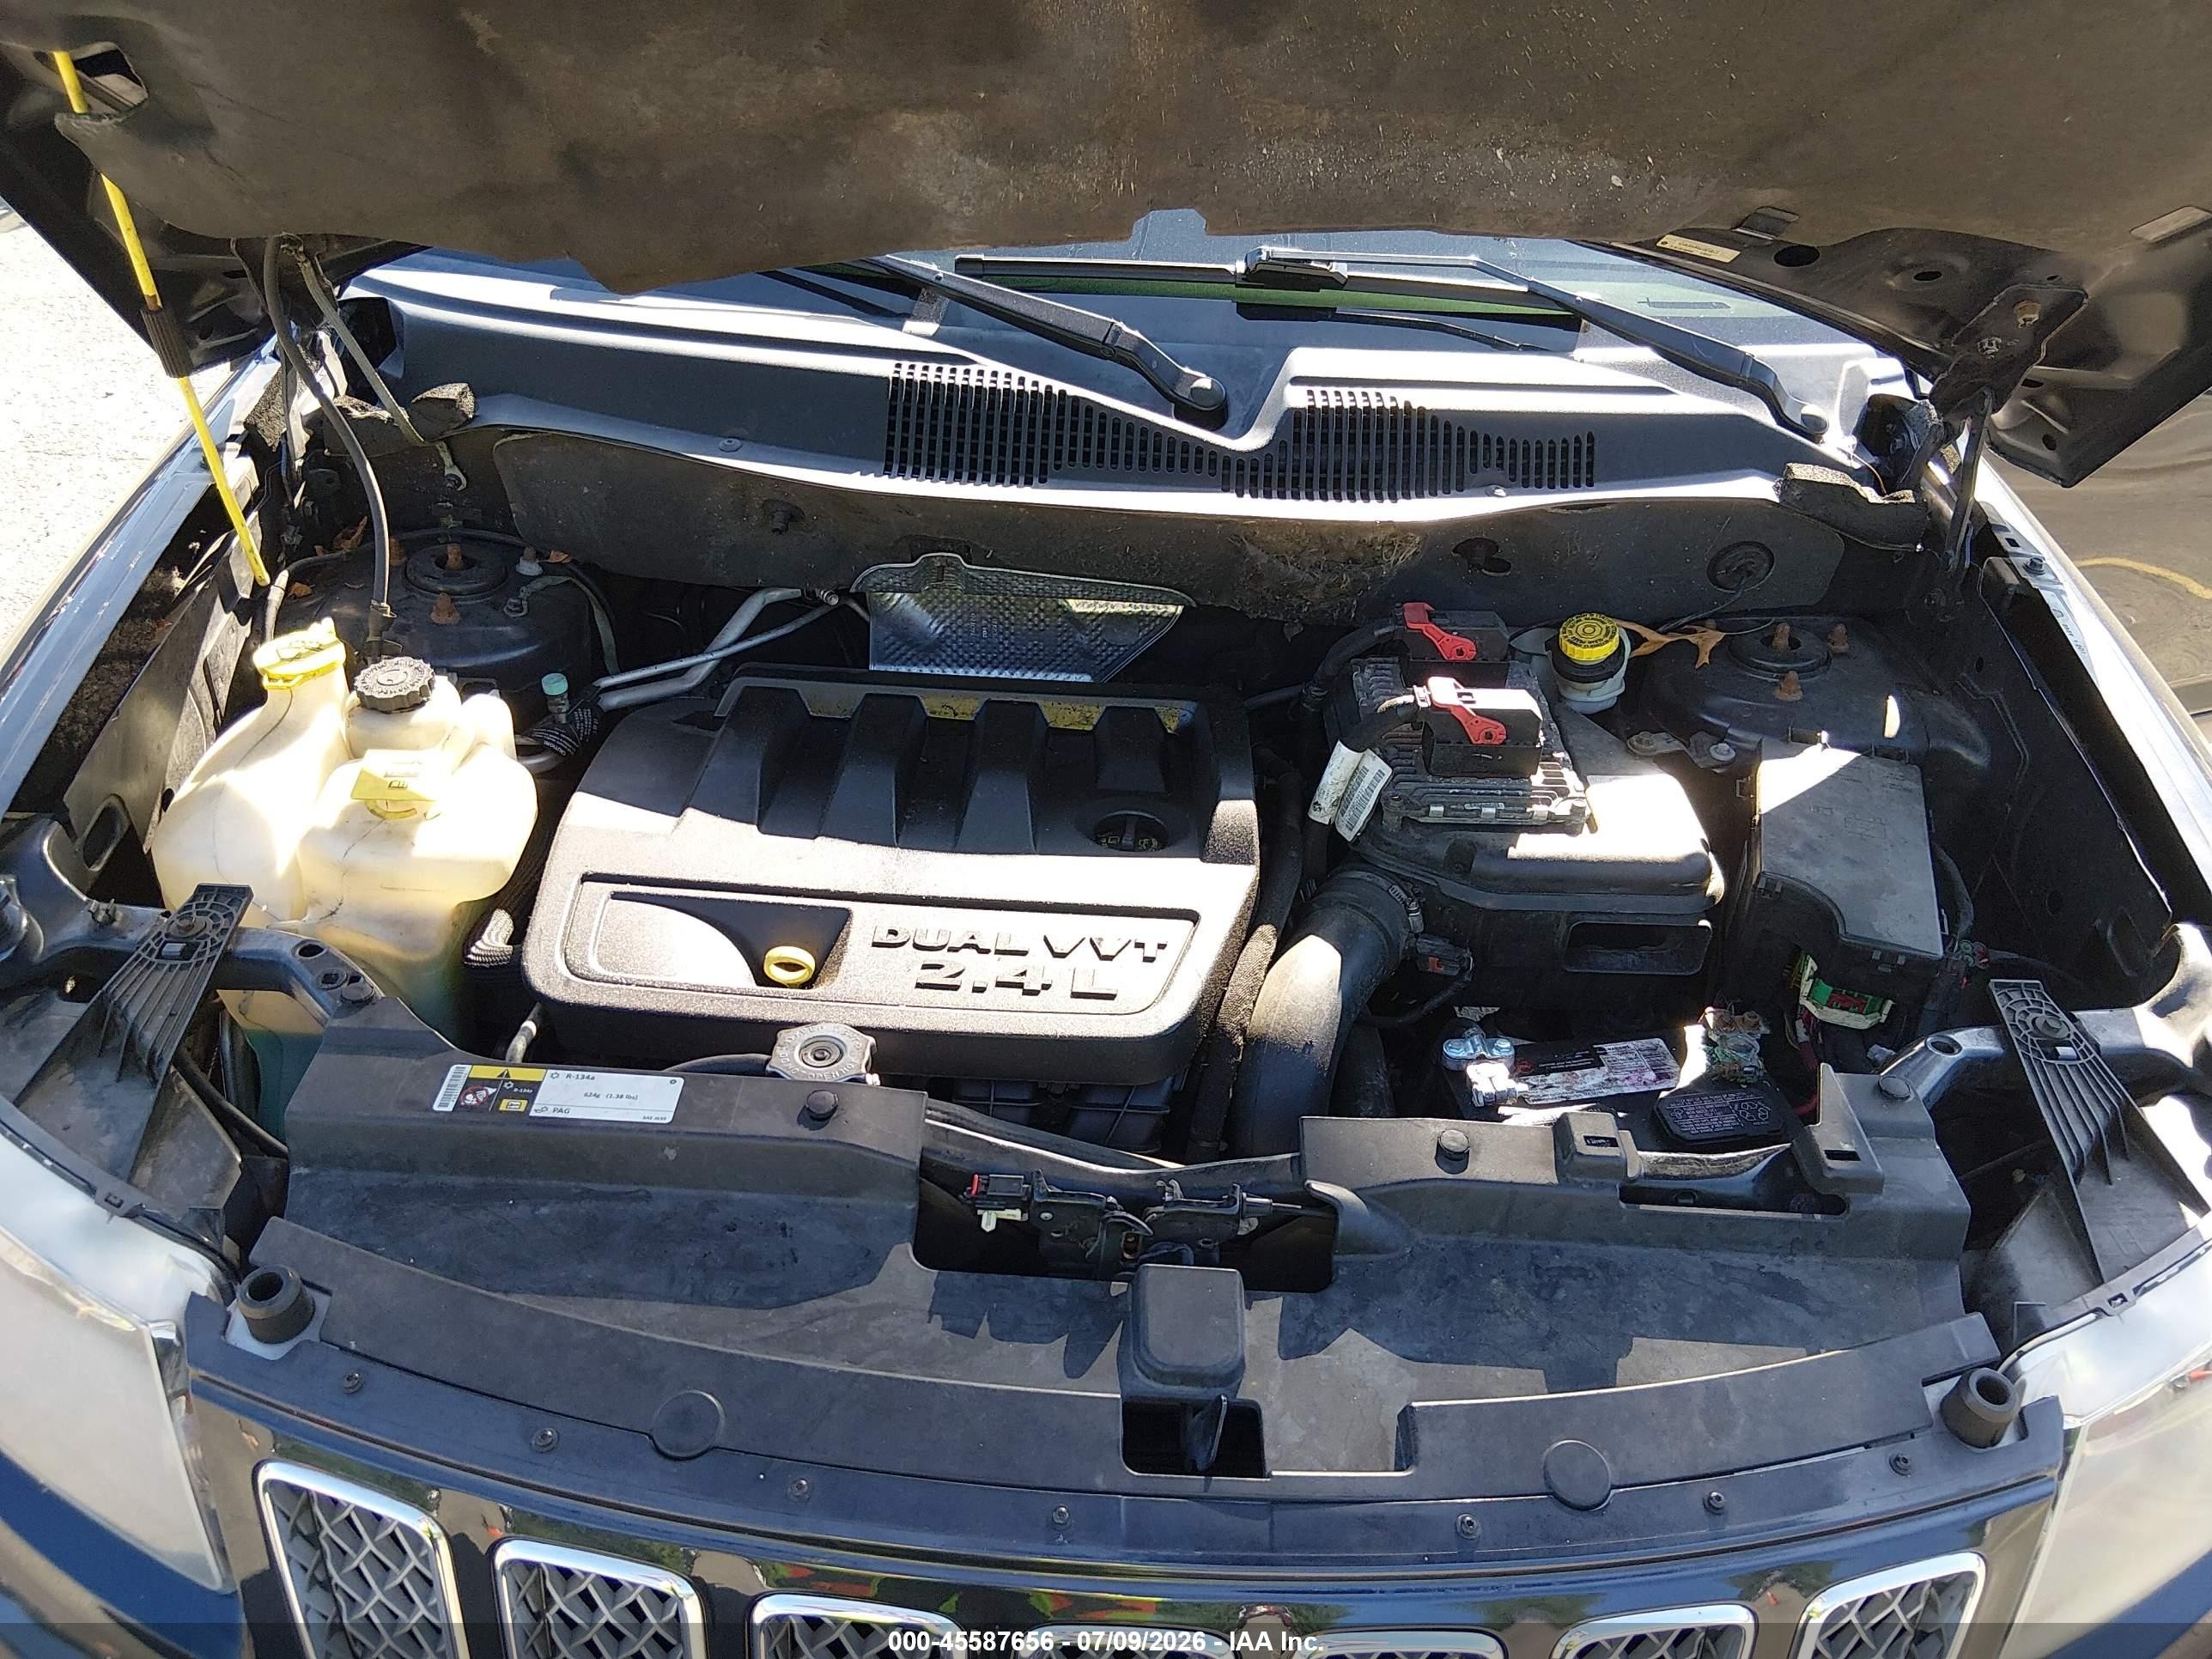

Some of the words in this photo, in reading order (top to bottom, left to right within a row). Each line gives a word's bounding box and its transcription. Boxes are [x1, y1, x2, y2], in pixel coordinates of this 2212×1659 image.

[872, 925, 1030, 956] DUAL
[1042, 935, 1168, 963] VVT
[915, 959, 1117, 1000] 2.4L
